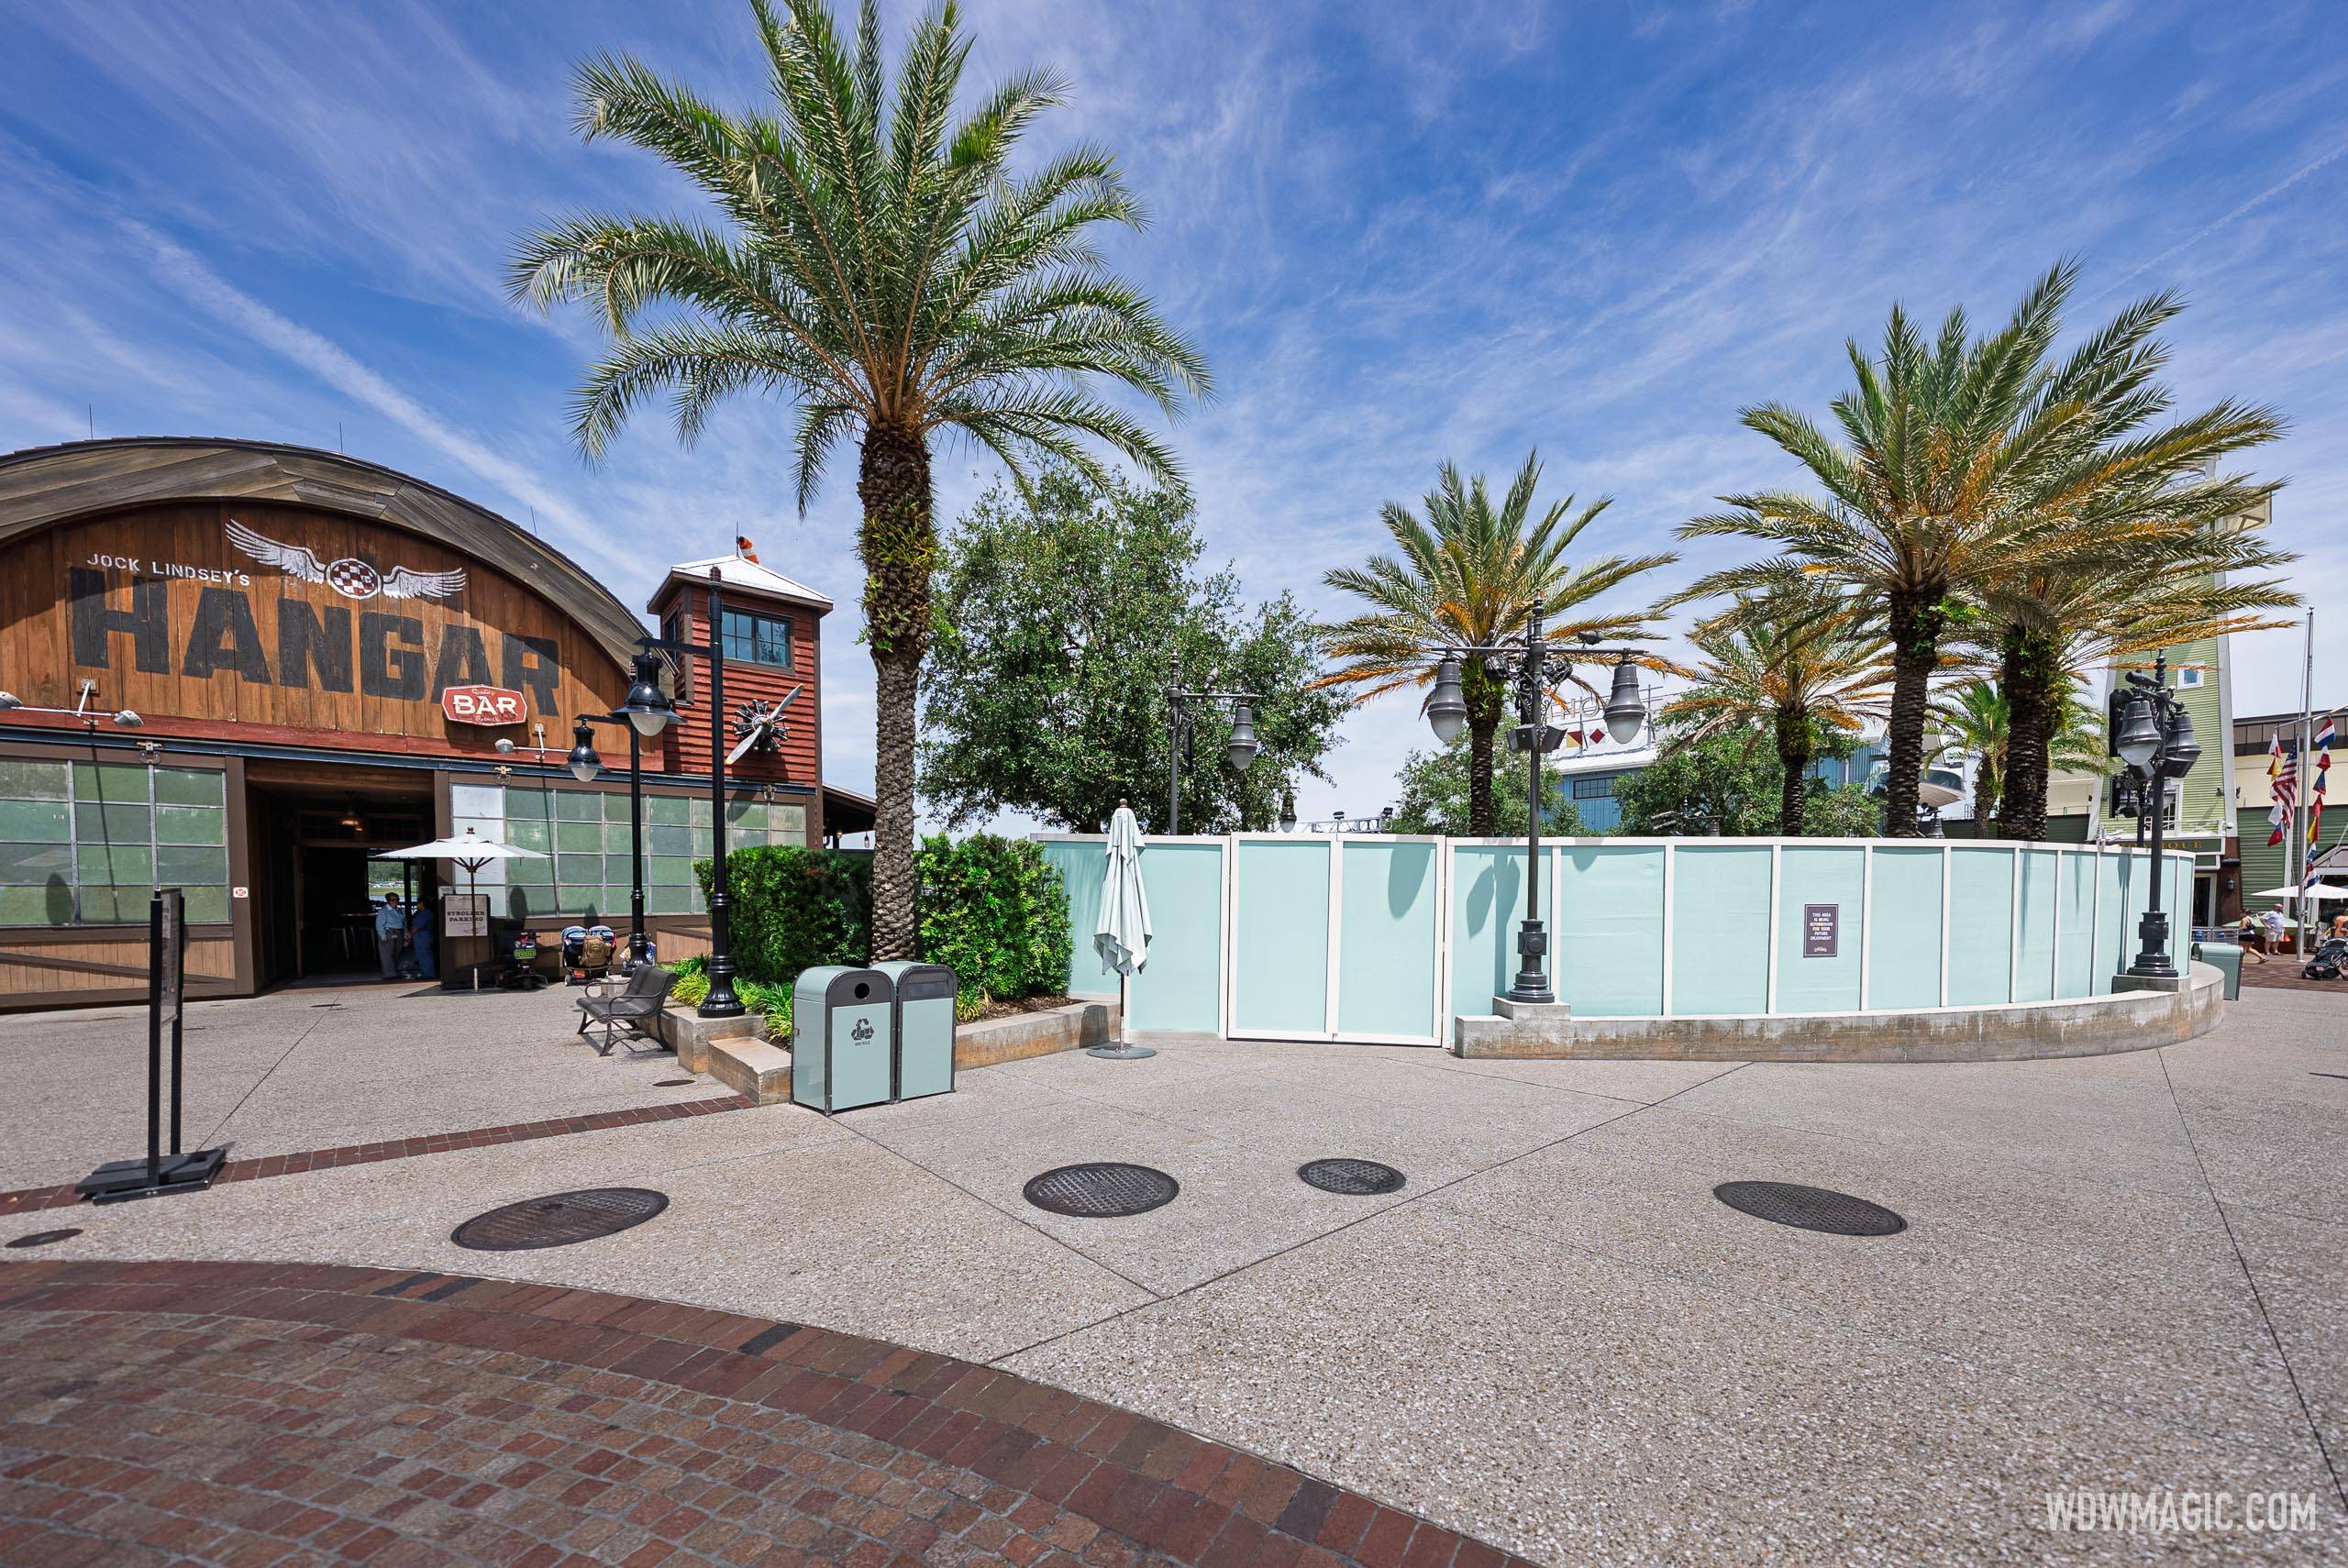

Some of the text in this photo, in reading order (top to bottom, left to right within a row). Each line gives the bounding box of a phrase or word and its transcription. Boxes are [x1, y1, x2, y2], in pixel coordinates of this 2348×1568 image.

[87, 553, 250, 587] JOCK LINDSEY'S
[71, 567, 560, 717] HANGAR
[452, 694, 518, 716] BAR
